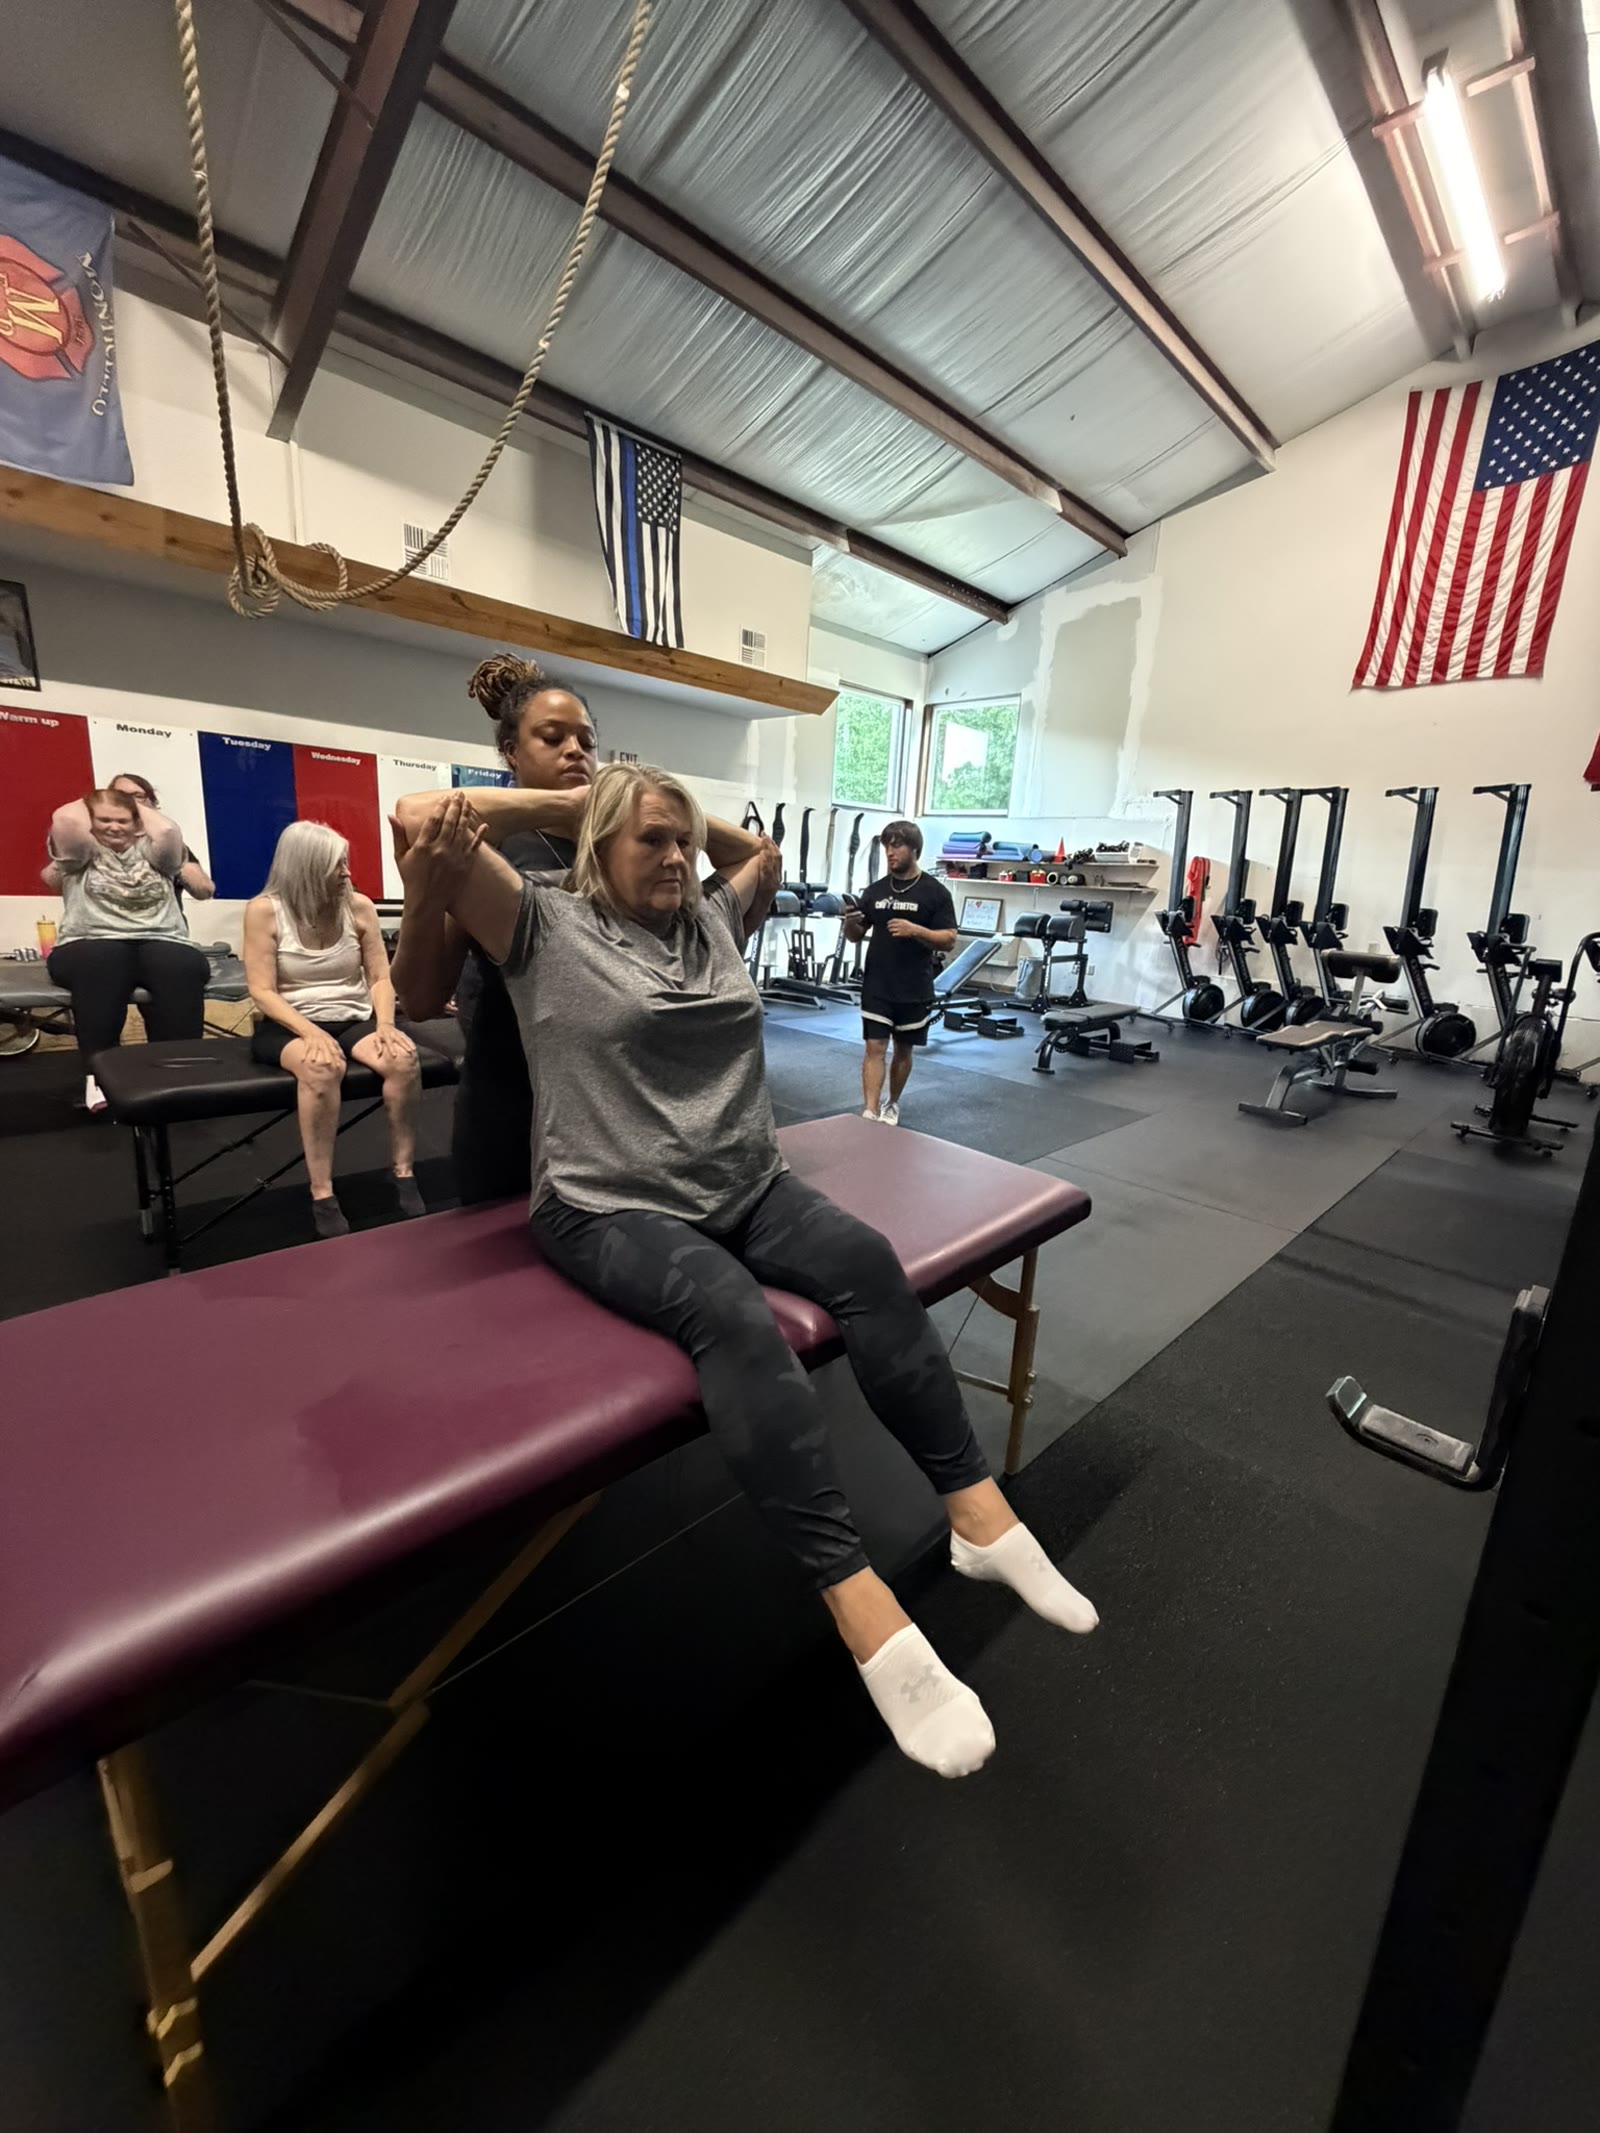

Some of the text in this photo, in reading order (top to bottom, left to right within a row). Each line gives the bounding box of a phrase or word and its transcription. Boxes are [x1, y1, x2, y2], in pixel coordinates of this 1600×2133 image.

[41, 717, 60, 728] up
[116, 723, 172, 738] Monday
[222, 736, 272, 751] Tuesday
[311, 751, 361, 765] Wednesday
[620, 751, 638, 764] EXIT
[393, 758, 437, 771] Thursday
[467, 768, 502, 779] Friday
